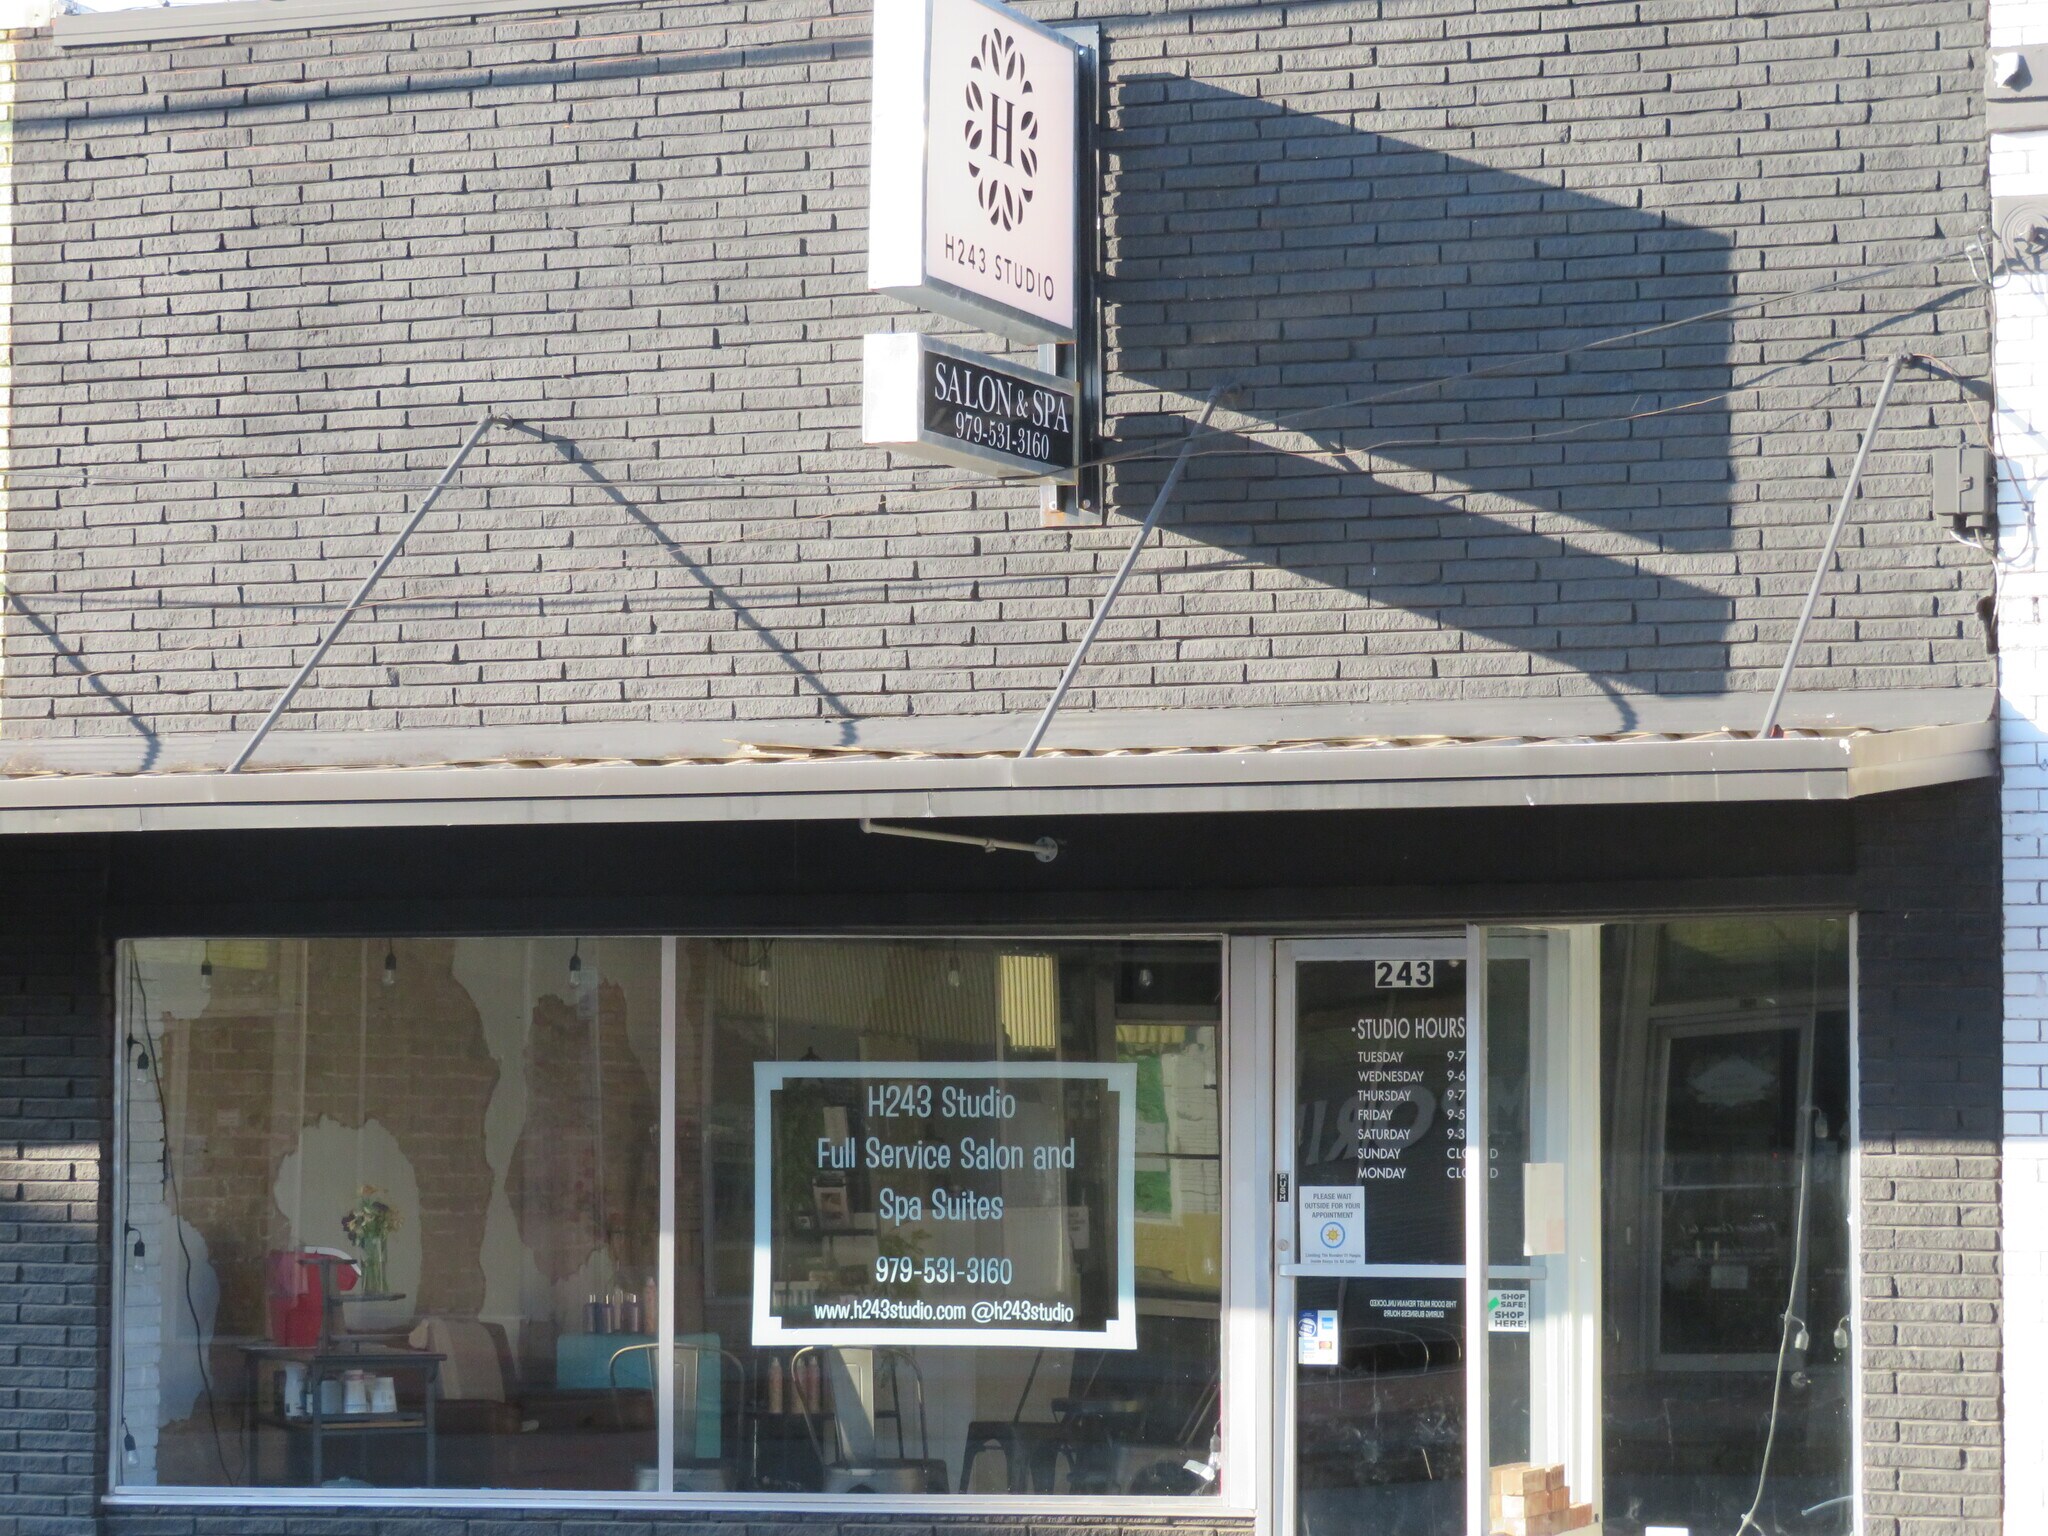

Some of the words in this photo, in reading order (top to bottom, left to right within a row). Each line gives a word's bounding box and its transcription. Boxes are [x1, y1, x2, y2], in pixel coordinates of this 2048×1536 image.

[989, 93, 1014, 167] H
[944, 233, 987, 273] H243
[995, 255, 1054, 301] STUDIO
[935, 361, 1013, 417] SALON
[1015, 389, 1028, 419] &
[1032, 389, 1070, 434] SPA
[955, 410, 1050, 460] 979-531-3160
[1377, 962, 1432, 986] 243
[1416, 1016, 1465, 1039] HOURS
[1358, 1051, 1404, 1063] TUESDAY
[1447, 1051, 1466, 1063] 9-7
[1358, 1071, 1424, 1082] WEDNESDAY
[1447, 1070, 1466, 1082] 9-6
[868, 1085, 932, 1119] H243
[941, 1085, 1016, 1119] Studio
[1358, 1090, 1411, 1102] THURSDAY
[1447, 1090, 1466, 1102] 9-7
[1358, 1110, 1392, 1121] FRIDAY
[1447, 1109, 1466, 1121] 9-5
[1358, 1129, 1410, 1140] SATURDAY
[1447, 1128, 1466, 1140] 9-3
[817, 1137, 855, 1169] Full
[866, 1136, 950, 1169] Service
[960, 1138, 1023, 1170] Salon
[1033, 1138, 1075, 1170] and
[1358, 1148, 1400, 1159] SUNDAY
[1447, 1148, 1498, 1159] CLD
[1358, 1168, 1406, 1178] MONDAY
[1447, 1168, 1498, 1178] CLD
[879, 1187, 922, 1226] Spa
[931, 1189, 1004, 1221] Suites
[875, 1257, 1013, 1285] 979-531-3160
[814, 1300, 966, 1320] www.h243studio.com
[971, 1300, 1074, 1323] @h243studio
